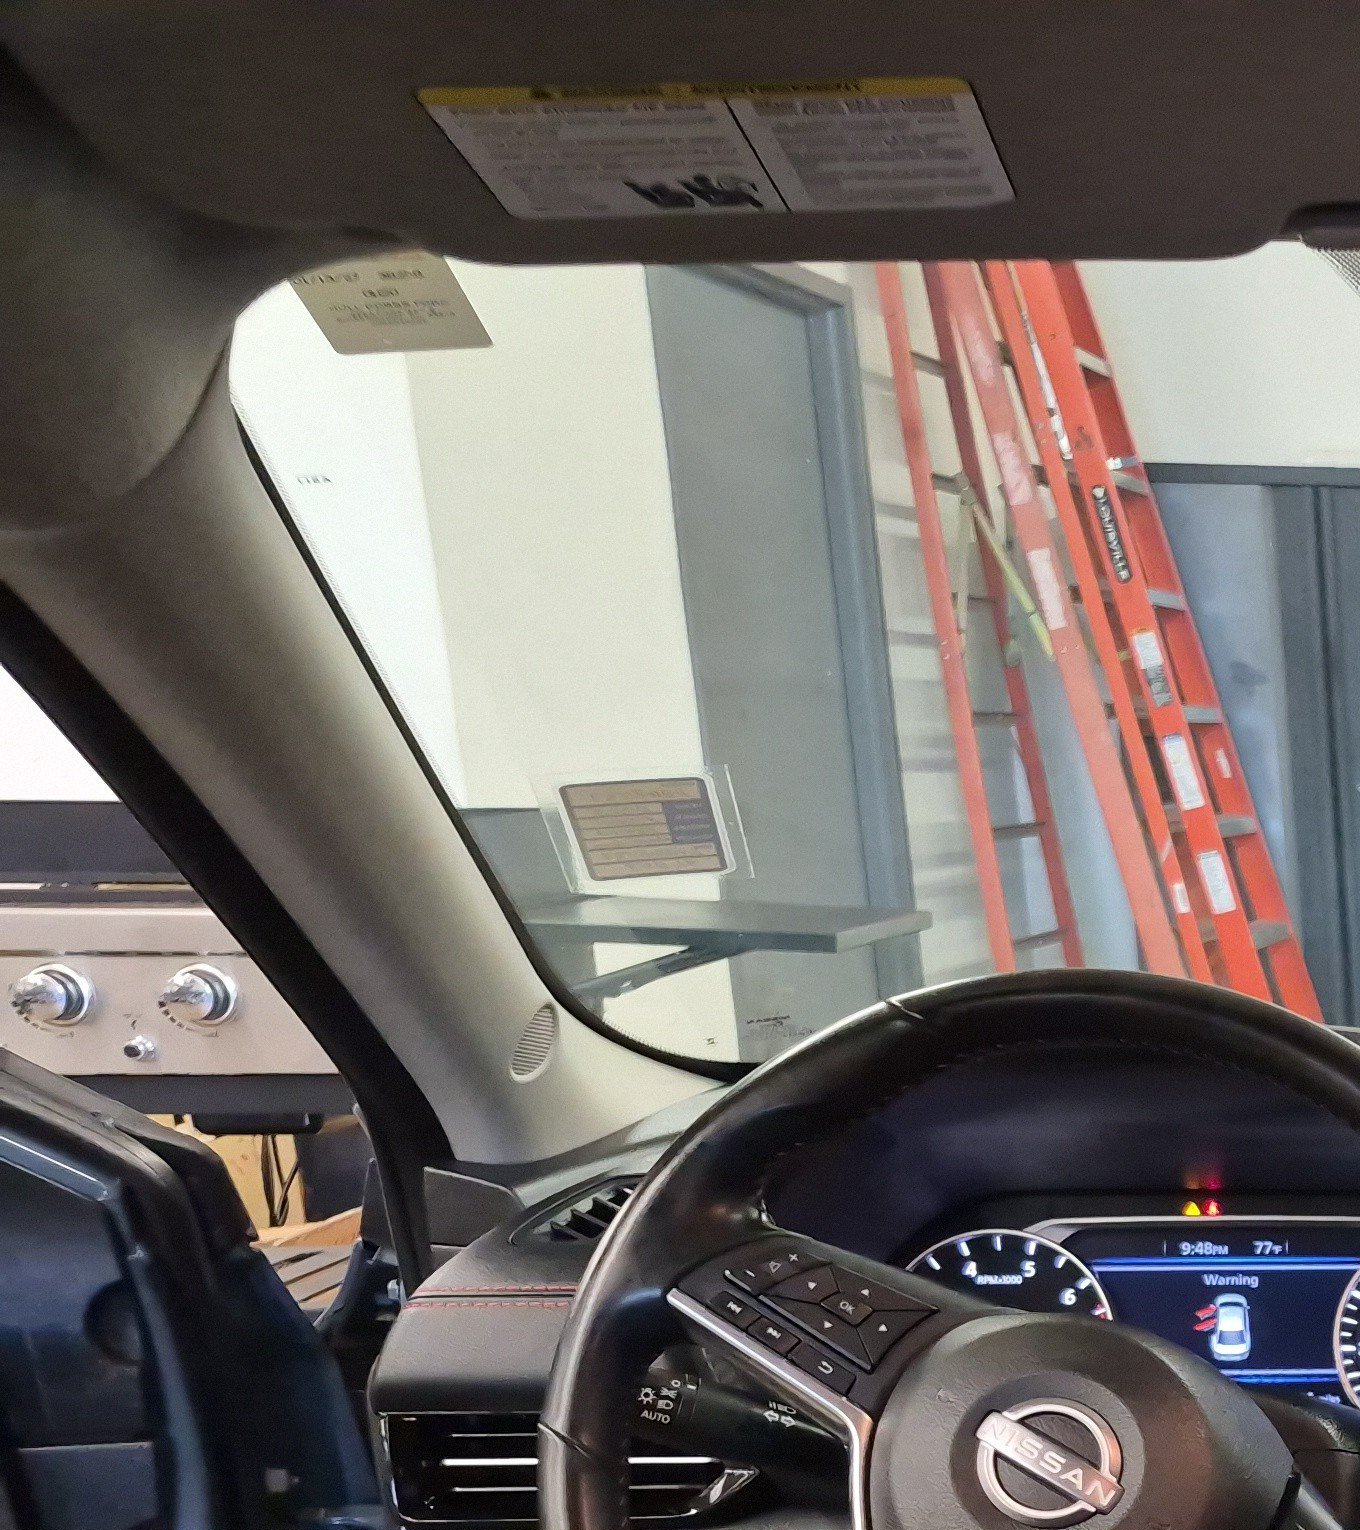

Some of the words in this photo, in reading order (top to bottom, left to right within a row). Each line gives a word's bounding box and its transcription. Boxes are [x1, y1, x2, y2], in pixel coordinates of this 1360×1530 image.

[961, 1260, 977, 1278] 4
[1020, 1260, 1036, 1278] 5
[1202, 1273, 1259, 1289] Warning
[1059, 1288, 1077, 1306] 6
[840, 1300, 856, 1315] OK
[640, 1409, 671, 1425] AUTO
[983, 1414, 1116, 1507] NISSAN
